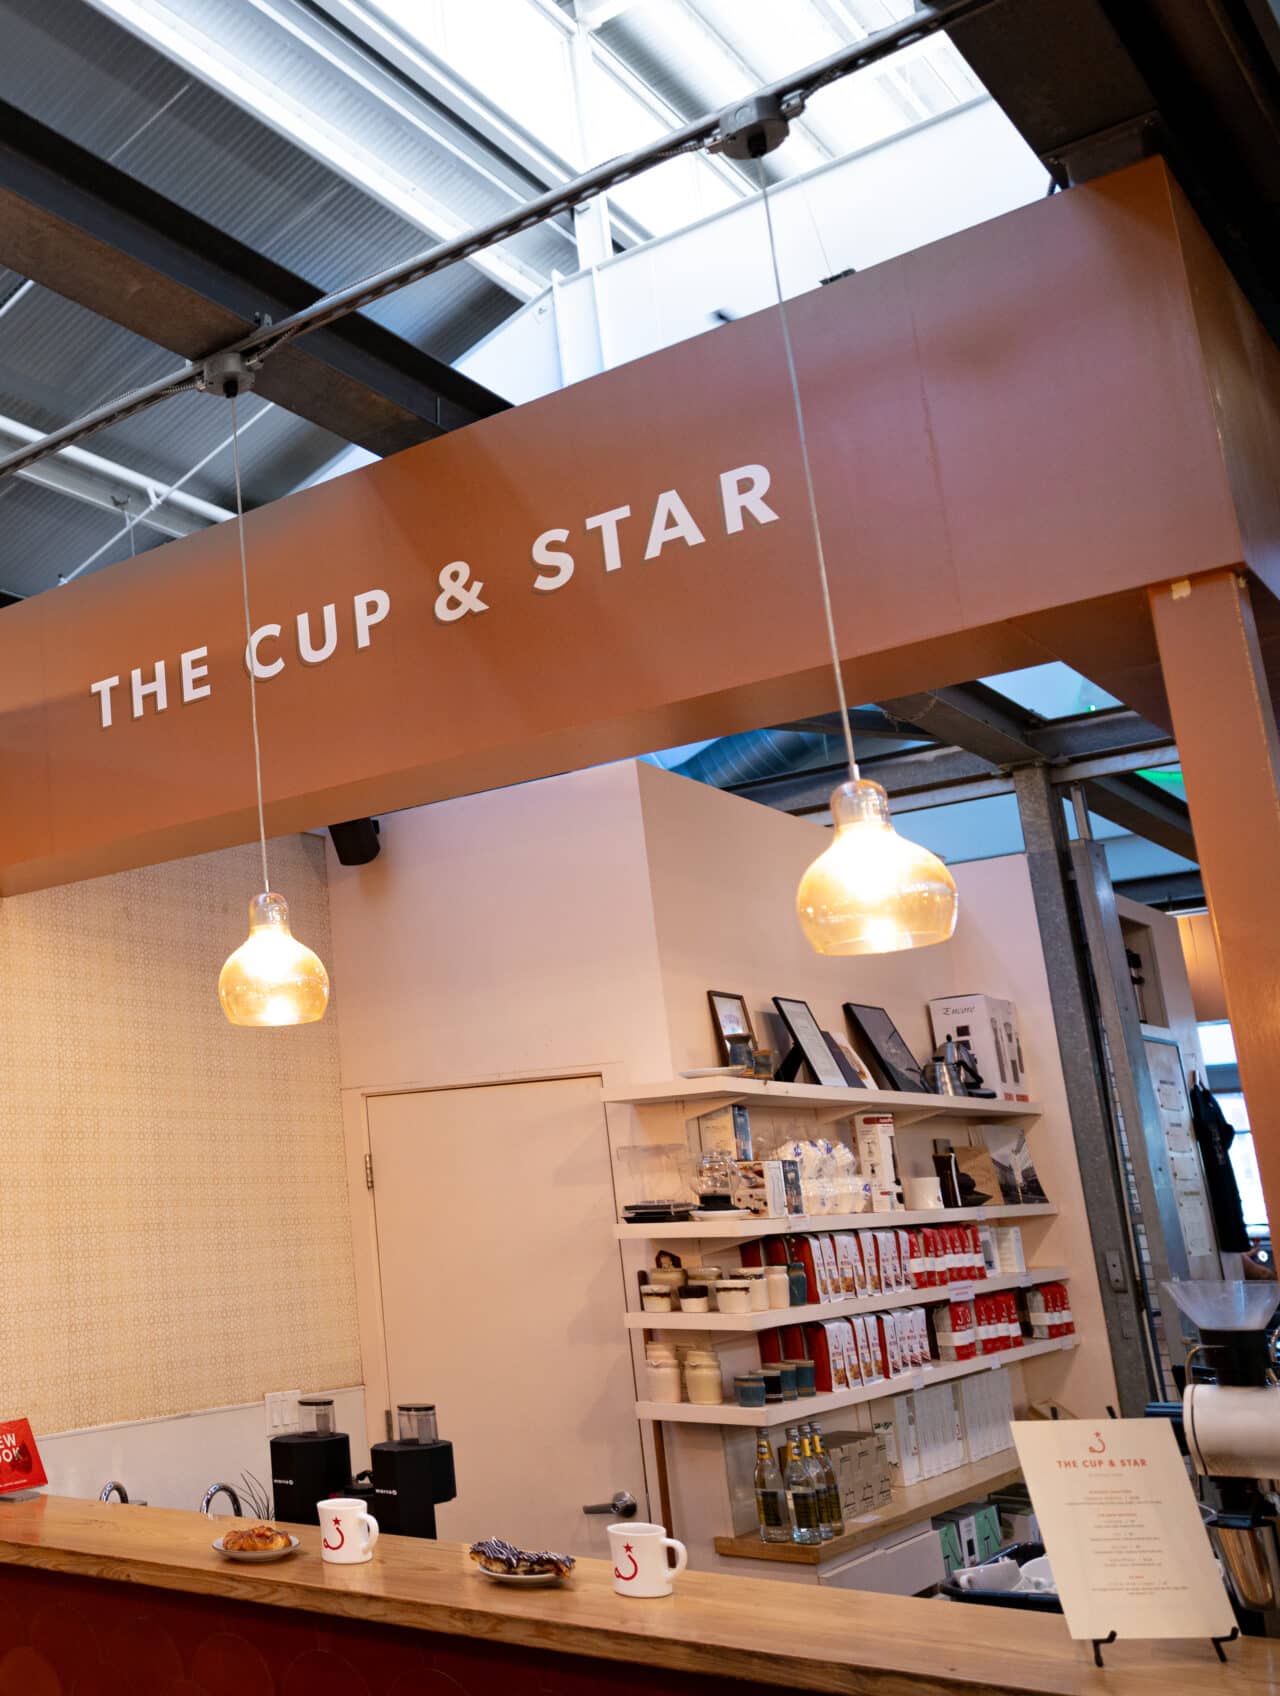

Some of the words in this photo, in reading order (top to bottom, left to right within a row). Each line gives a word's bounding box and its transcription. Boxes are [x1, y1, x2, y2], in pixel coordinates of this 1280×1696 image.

[91, 646, 211, 728] THE
[244, 588, 391, 680] CUP
[433, 560, 490, 623] &
[531, 463, 780, 592] STAR
[1056, 1459, 1079, 1468] THE
[1082, 1459, 1104, 1468] CUP
[1108, 1459, 1116, 1468] &
[1119, 1458, 1148, 1468] STAR
